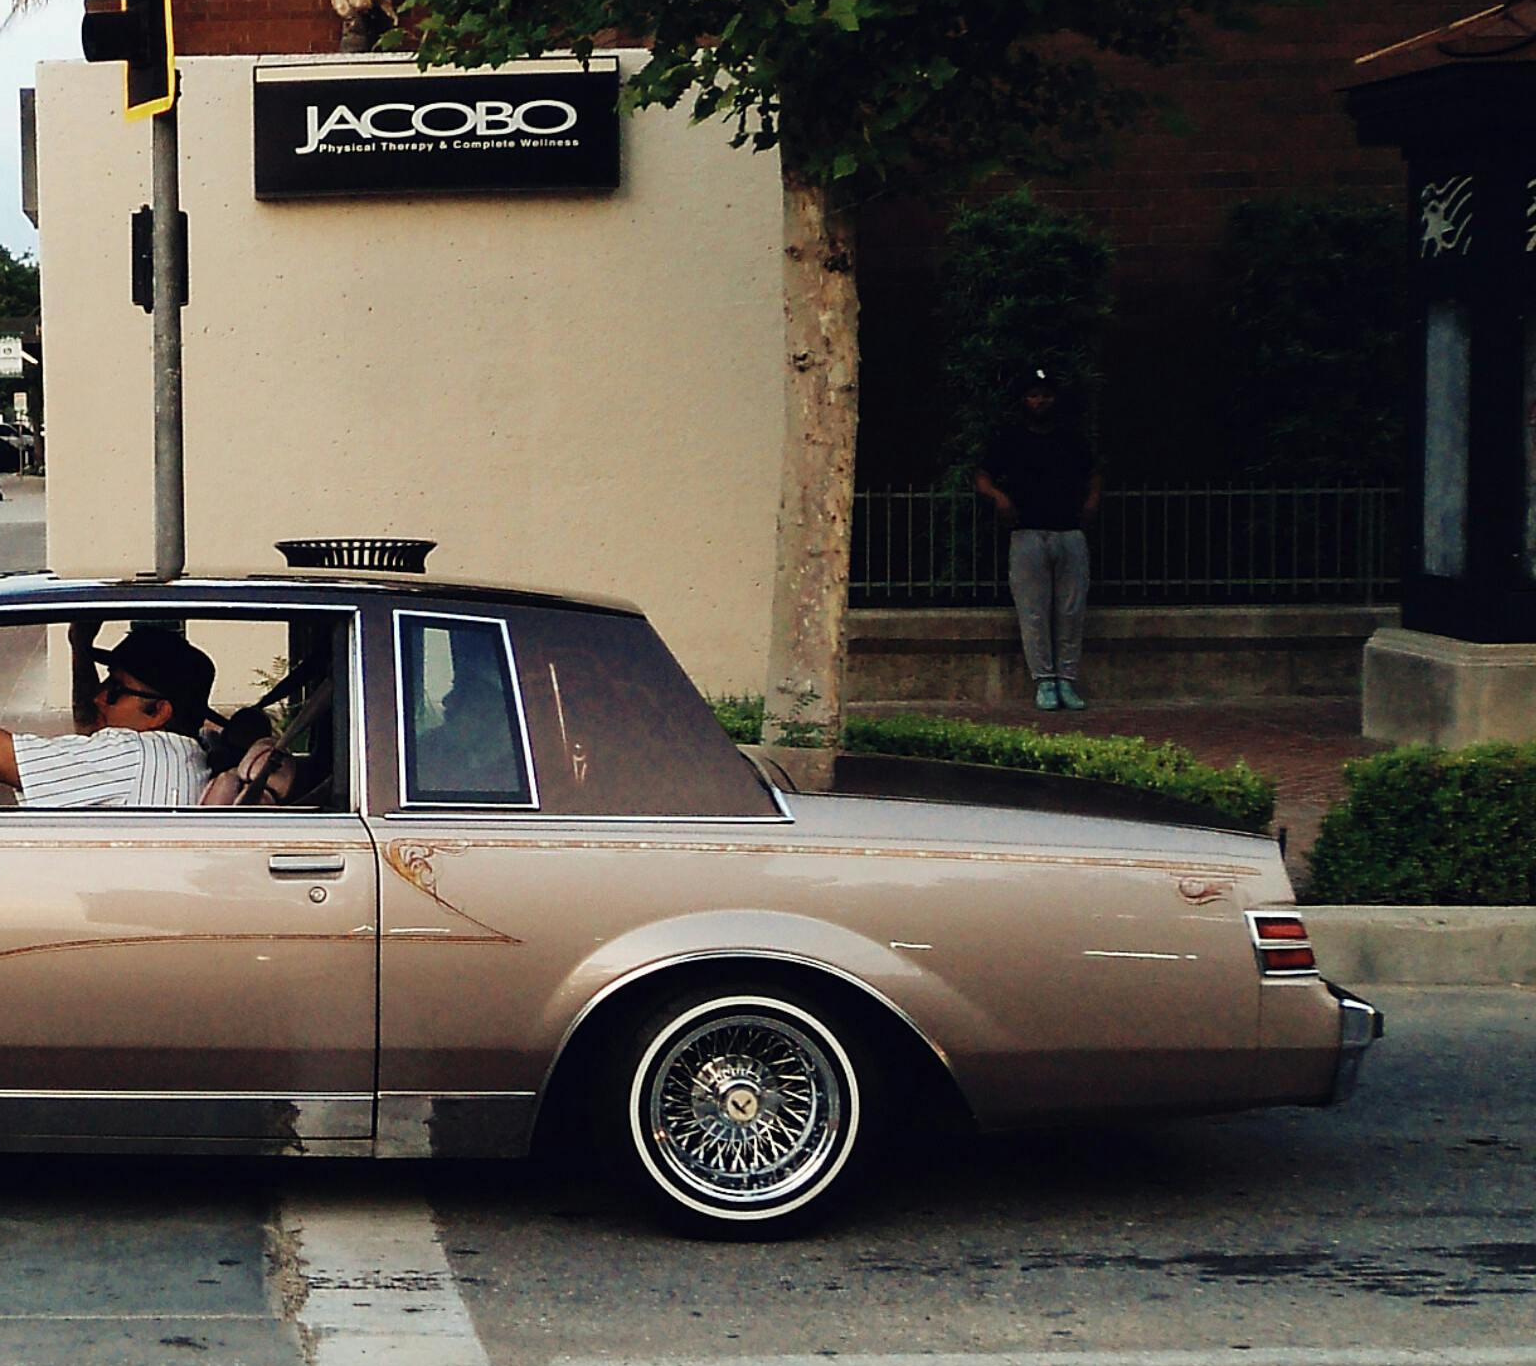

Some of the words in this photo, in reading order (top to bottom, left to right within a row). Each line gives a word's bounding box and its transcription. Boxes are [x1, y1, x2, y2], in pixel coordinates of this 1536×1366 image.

[295, 99, 578, 154] JACOBO
[319, 141, 376, 154] Physical
[380, 141, 434, 153] Therapy
[439, 140, 448, 150] &
[452, 138, 516, 151] Complete
[520, 137, 580, 149] Wellness
